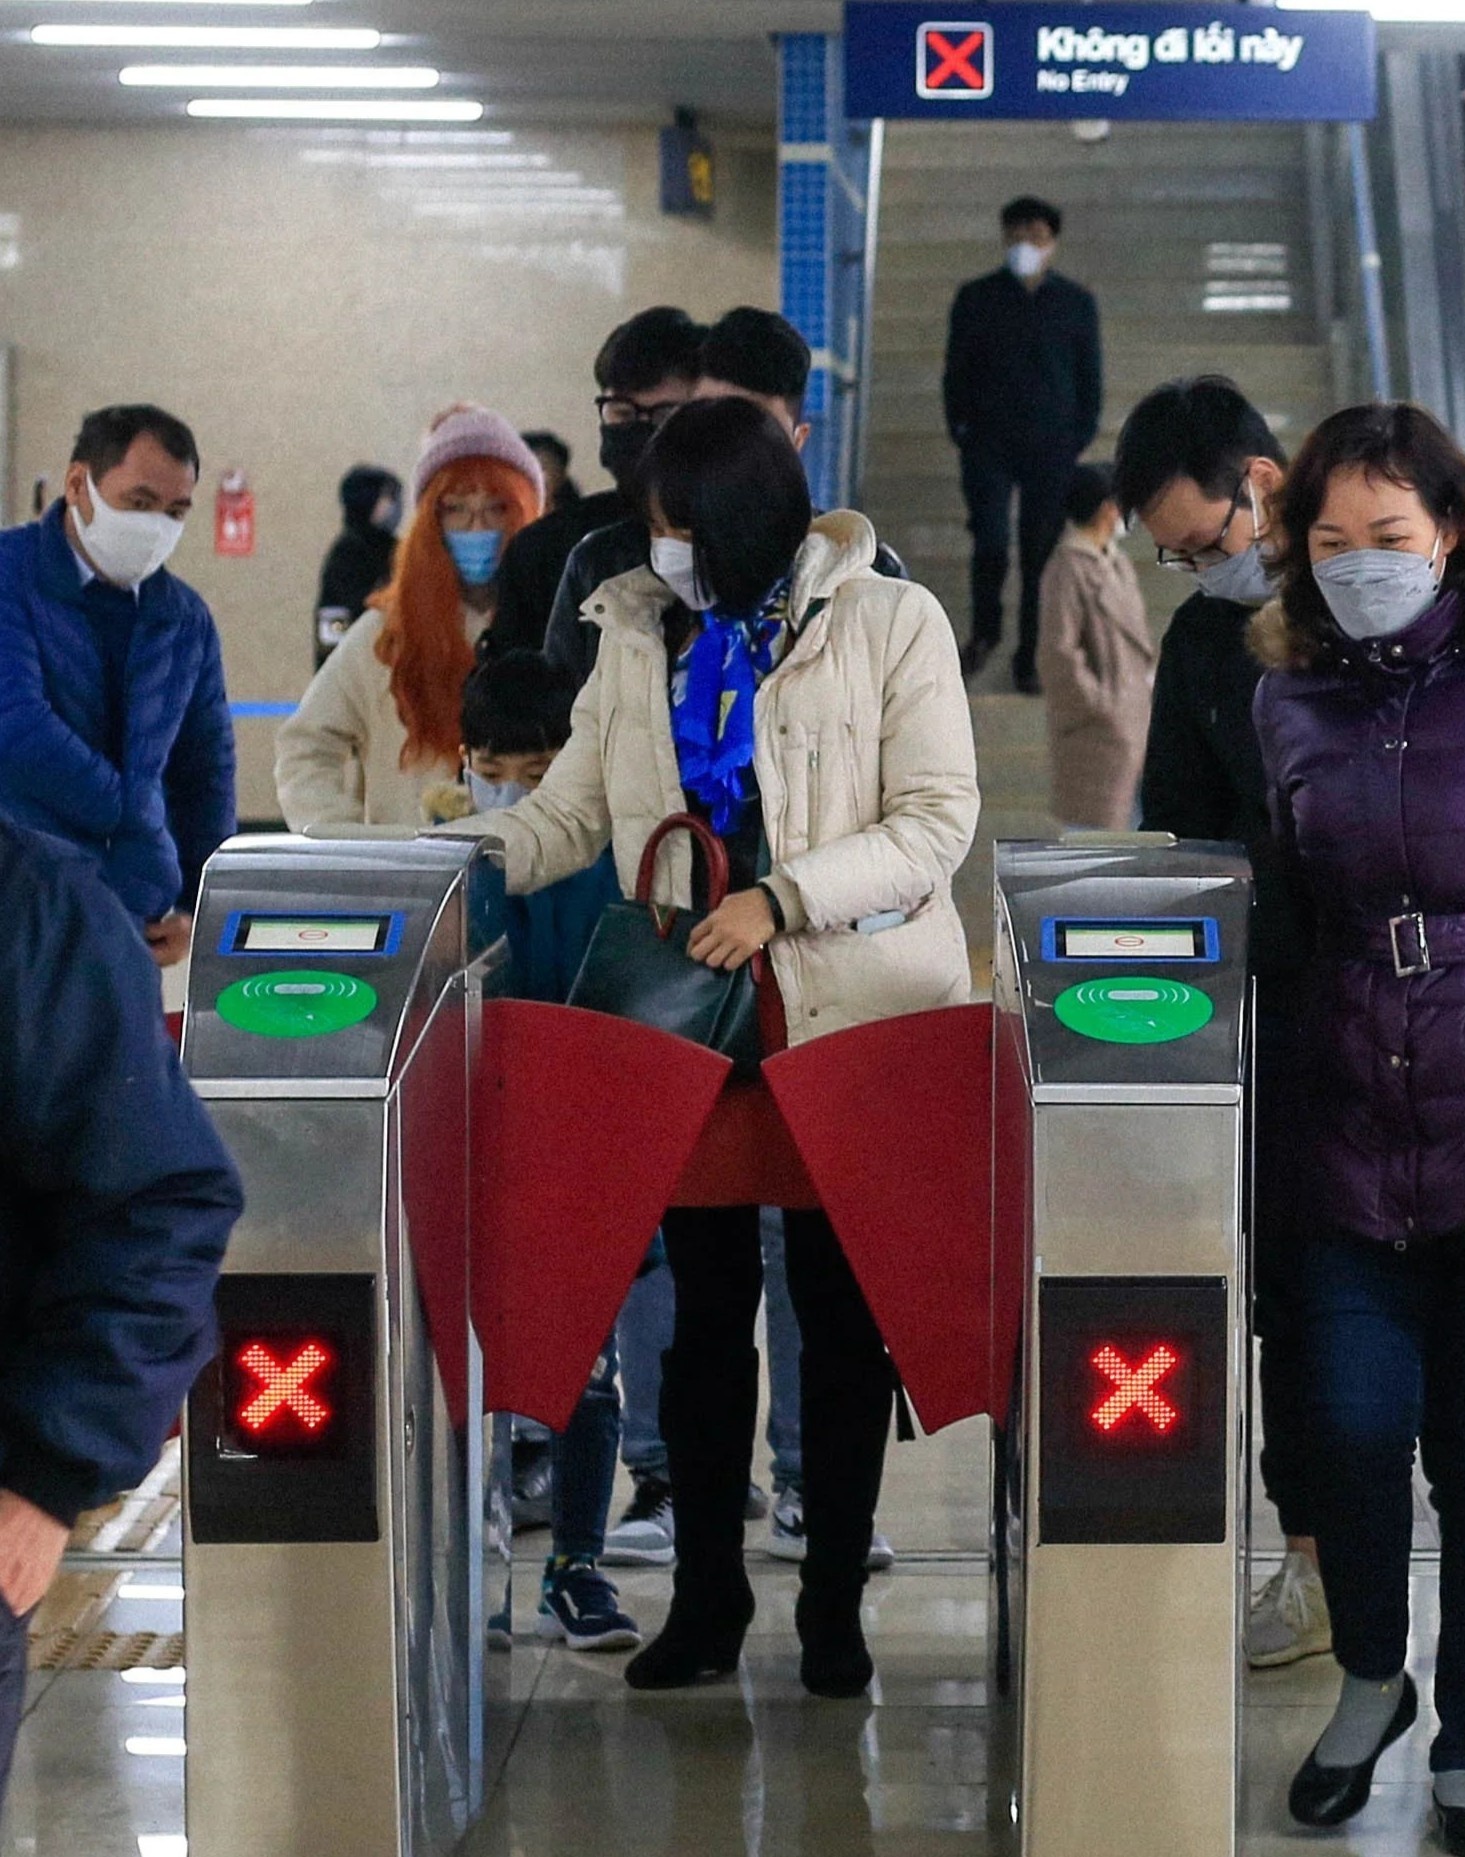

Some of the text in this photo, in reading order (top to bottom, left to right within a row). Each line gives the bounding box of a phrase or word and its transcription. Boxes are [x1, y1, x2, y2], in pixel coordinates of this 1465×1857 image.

[1037, 20, 1304, 71] Không đi lối này
[1037, 68, 1130, 97] No Entry
